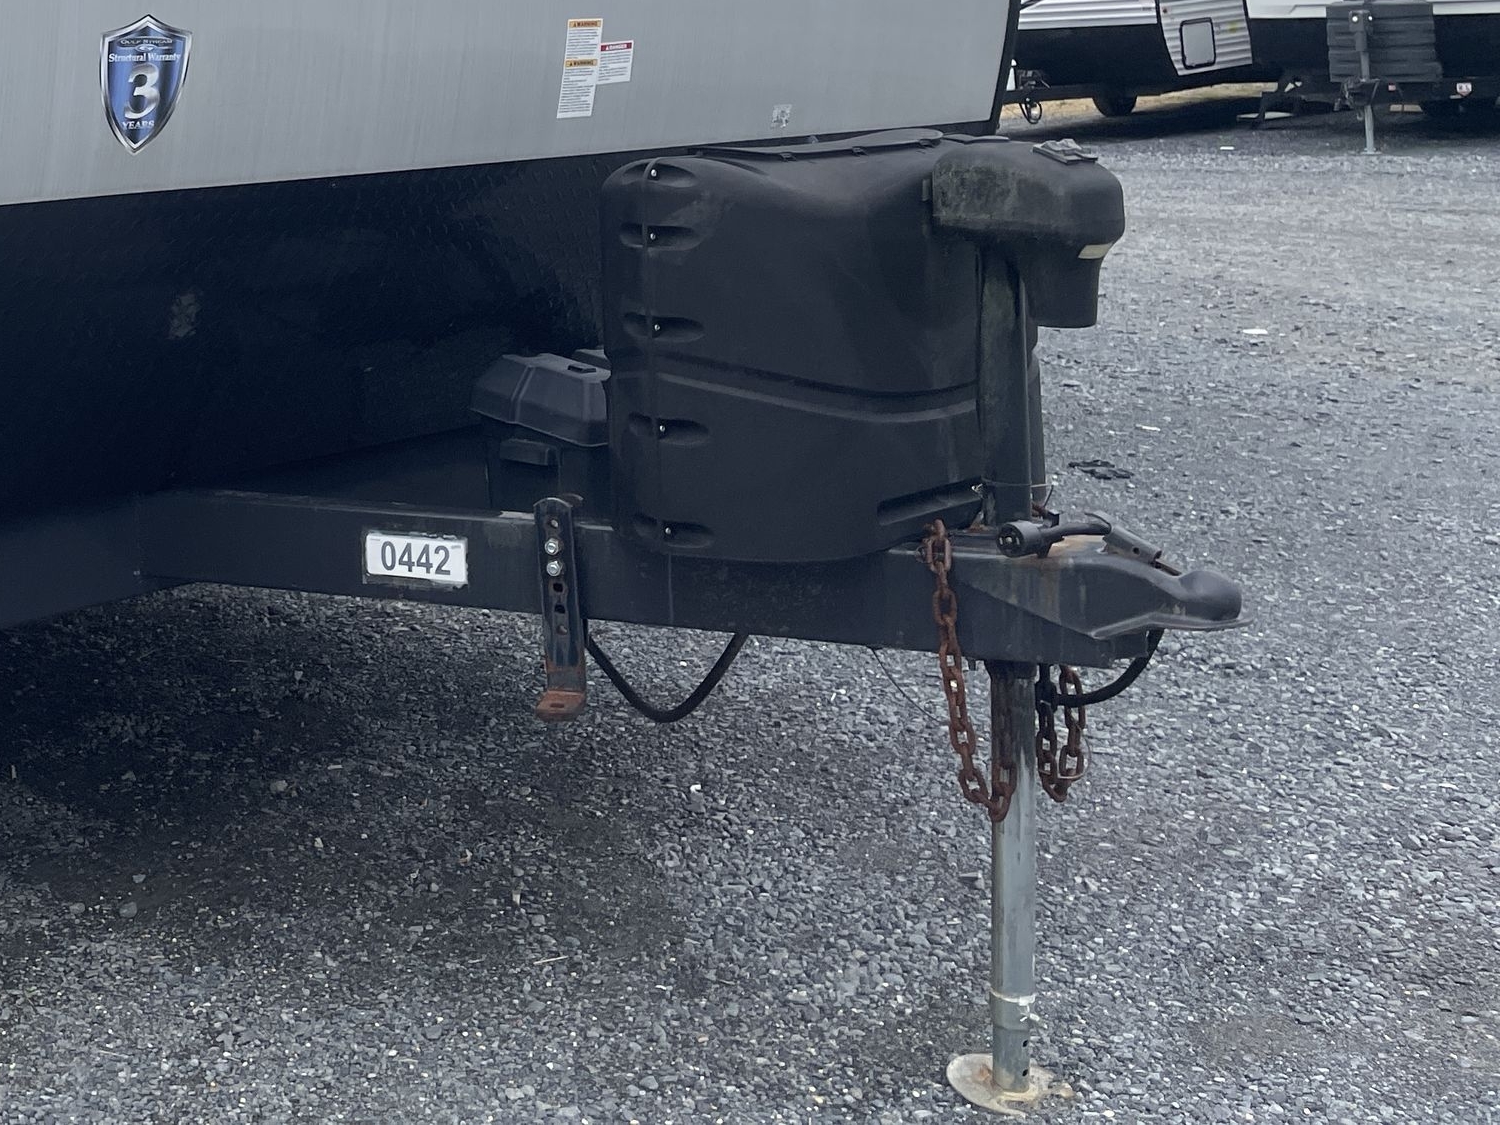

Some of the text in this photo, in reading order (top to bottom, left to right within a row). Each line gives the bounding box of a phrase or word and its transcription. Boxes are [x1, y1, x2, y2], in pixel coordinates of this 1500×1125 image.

[108, 53, 181, 63] Structural Warranty
[124, 63, 161, 119] 3
[122, 120, 155, 130] YEARS
[381, 541, 451, 575] 0442
